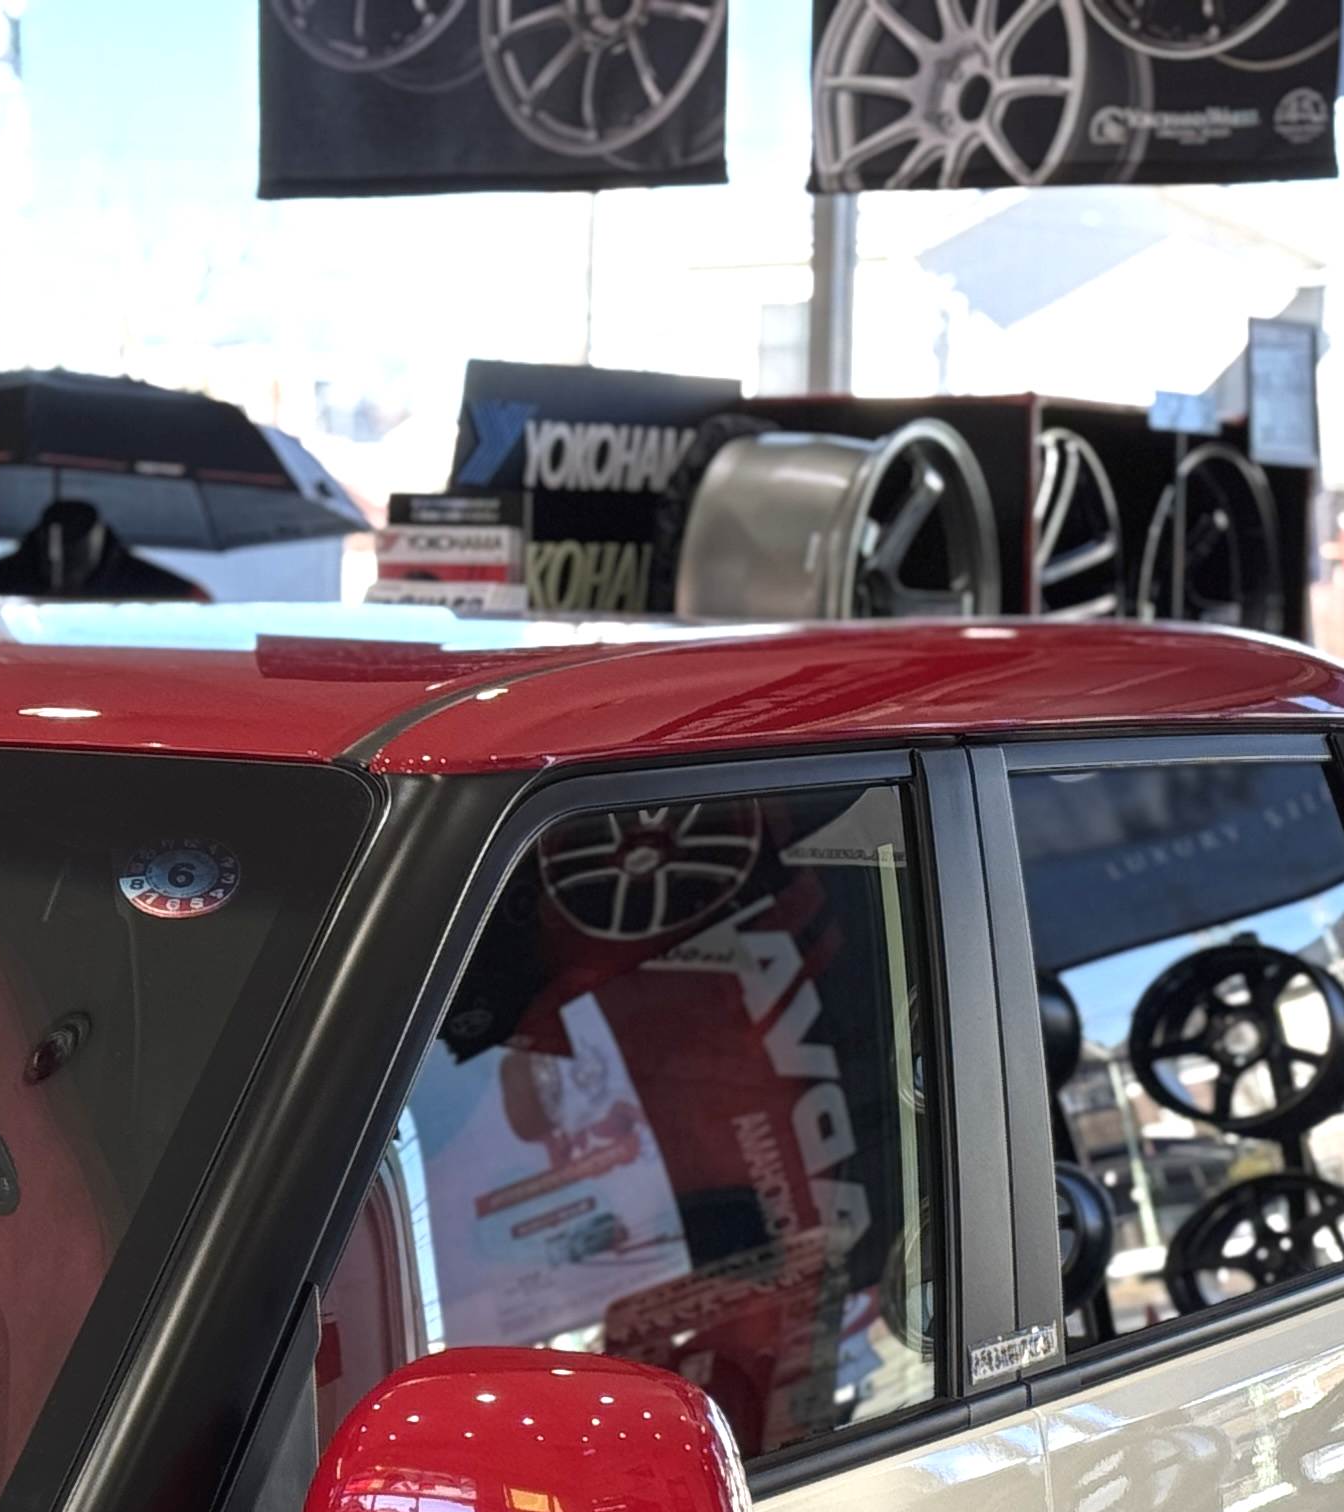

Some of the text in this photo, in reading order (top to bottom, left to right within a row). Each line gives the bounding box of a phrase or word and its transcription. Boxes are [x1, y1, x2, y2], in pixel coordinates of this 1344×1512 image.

[523, 419, 696, 494] YOKOHAM
[129, 878, 145, 891] 8
[167, 862, 197, 888] 6
